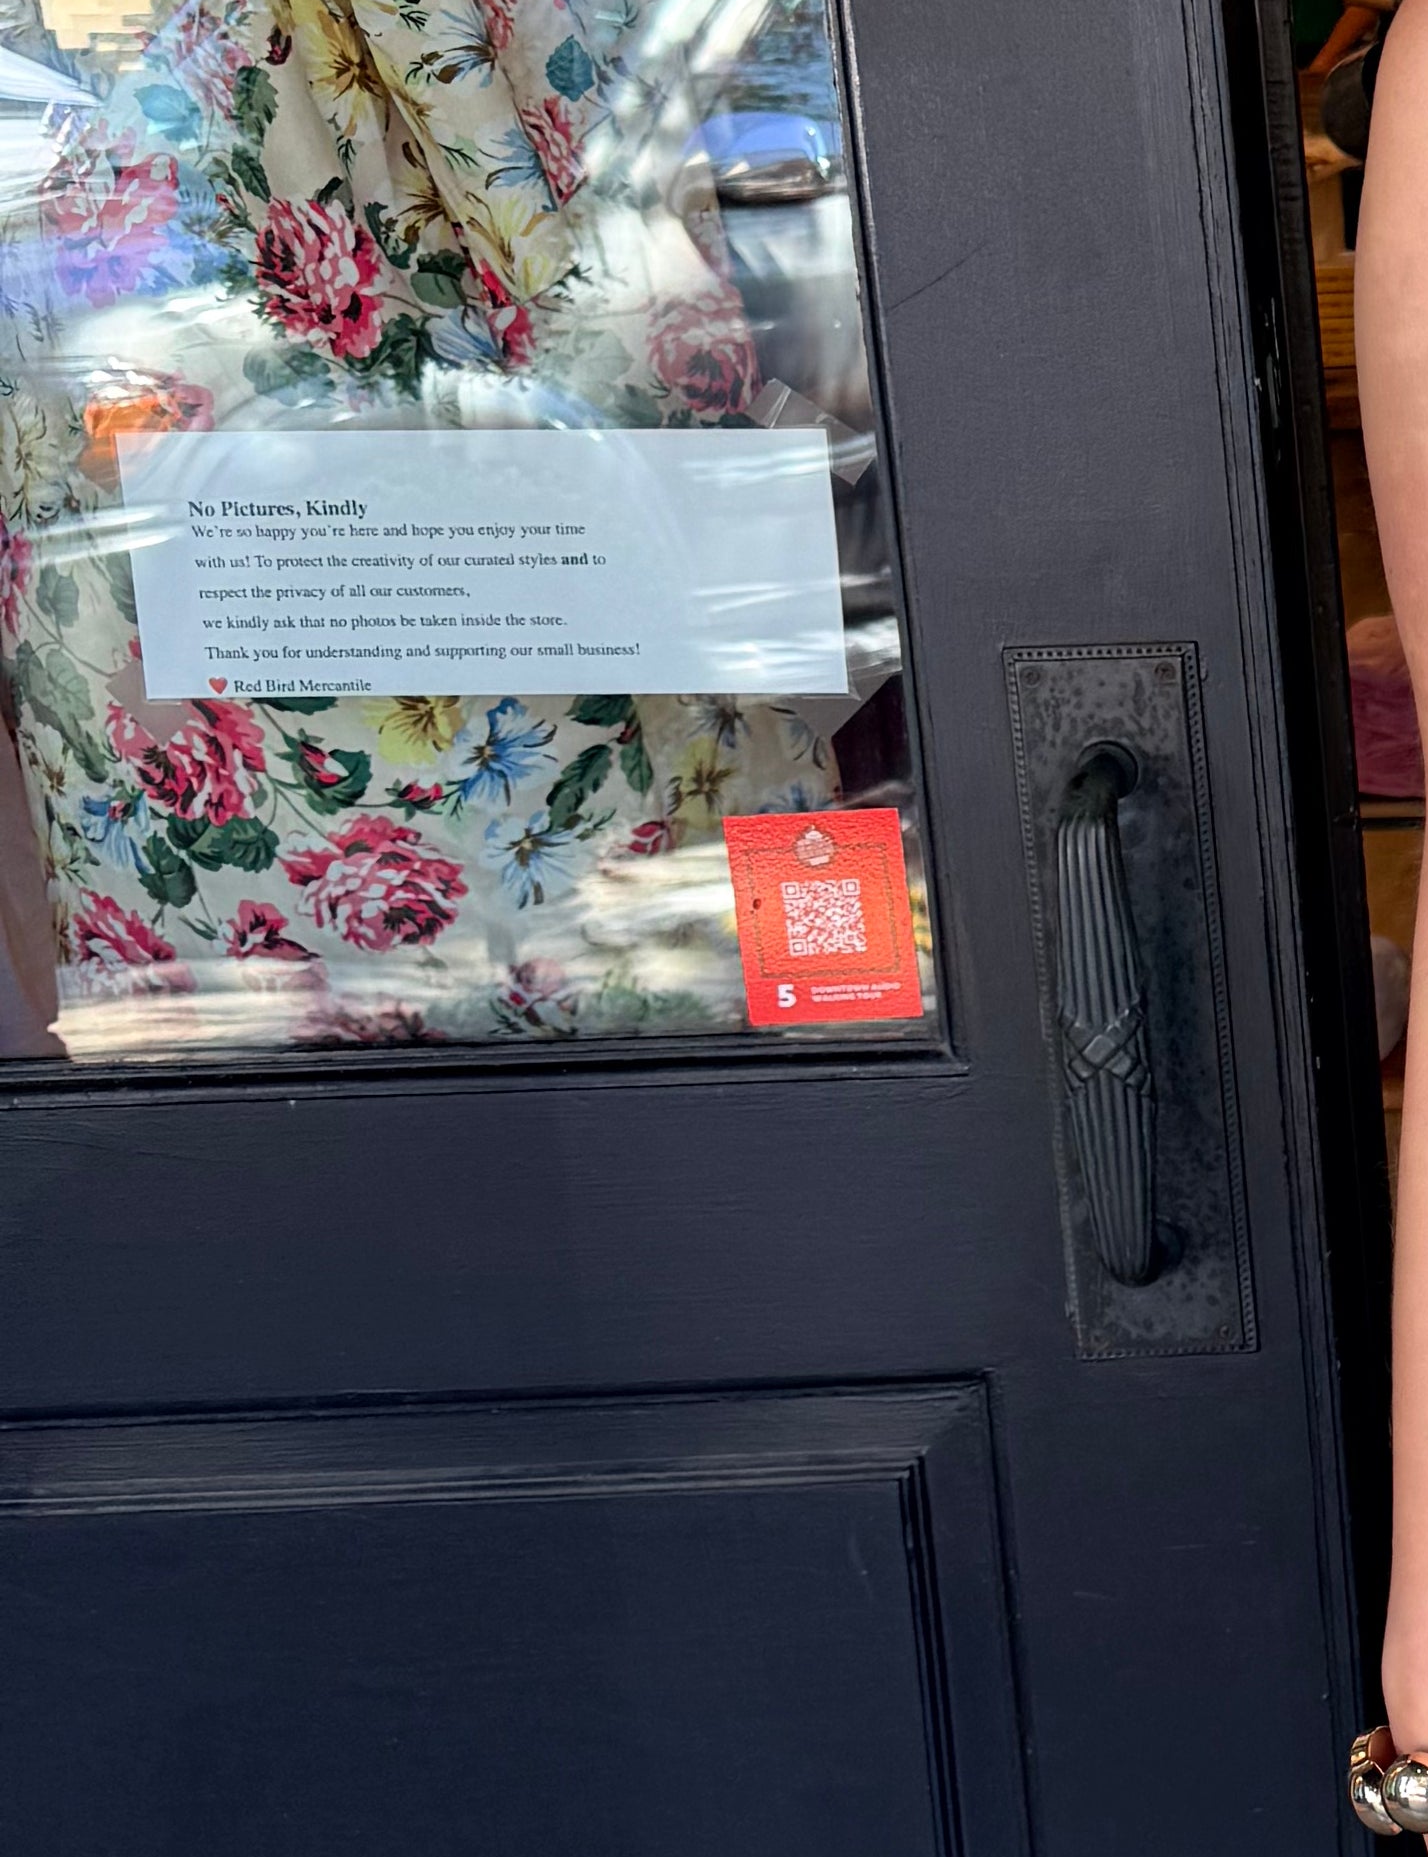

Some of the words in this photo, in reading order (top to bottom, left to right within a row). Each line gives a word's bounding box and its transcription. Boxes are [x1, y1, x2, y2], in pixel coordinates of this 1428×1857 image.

[188, 500, 215, 517] No
[221, 500, 301, 519] Pictures,
[306, 499, 368, 520] Kindly
[192, 524, 232, 538] We're
[237, 528, 252, 537] so
[256, 524, 296, 541] happy
[301, 525, 345, 540] you're
[350, 524, 379, 537] here
[383, 523, 408, 537] and
[411, 523, 445, 539] hope
[449, 526, 474, 539] you
[478, 522, 516, 539] enjoy
[521, 524, 551, 538] your
[555, 522, 586, 535] time
[194, 555, 226, 568] with
[230, 555, 251, 568] us!
[253, 554, 272, 568] To
[276, 555, 323, 571] protect
[327, 554, 347, 567] the
[351, 553, 415, 570] creativity
[419, 553, 434, 566] of
[437, 556, 461, 566] our
[464, 553, 515, 566] curated
[518, 552, 558, 568] styles
[561, 552, 588, 565] and
[592, 554, 606, 565] to
[199, 587, 247, 601] respect
[251, 585, 272, 598] the
[276, 585, 326, 601] privacy
[330, 584, 346, 597] of
[349, 584, 366, 597] all
[370, 587, 392, 597] our
[396, 585, 471, 598] customers,
[203, 620, 222, 629] we
[226, 615, 269, 631] kindly
[273, 615, 295, 629] ask
[299, 615, 325, 628] that
[330, 618, 347, 628] no
[351, 615, 397, 630] photos
[400, 614, 416, 627] be
[420, 614, 457, 626] taken
[461, 613, 501, 626] inside
[505, 613, 525, 626] the
[529, 615, 568, 626] store.
[204, 645, 249, 660] Thank
[252, 648, 279, 661] you
[282, 645, 302, 658] for
[305, 644, 403, 660] understanding
[406, 644, 430, 657] and
[434, 644, 507, 660] supporting
[510, 647, 533, 656] our
[537, 643, 573, 656] small
[577, 643, 640, 656] business!
[234, 678, 262, 693] Red
[266, 678, 295, 693] Bird
[299, 678, 372, 693] Mercantile
[777, 984, 797, 1008] 5
